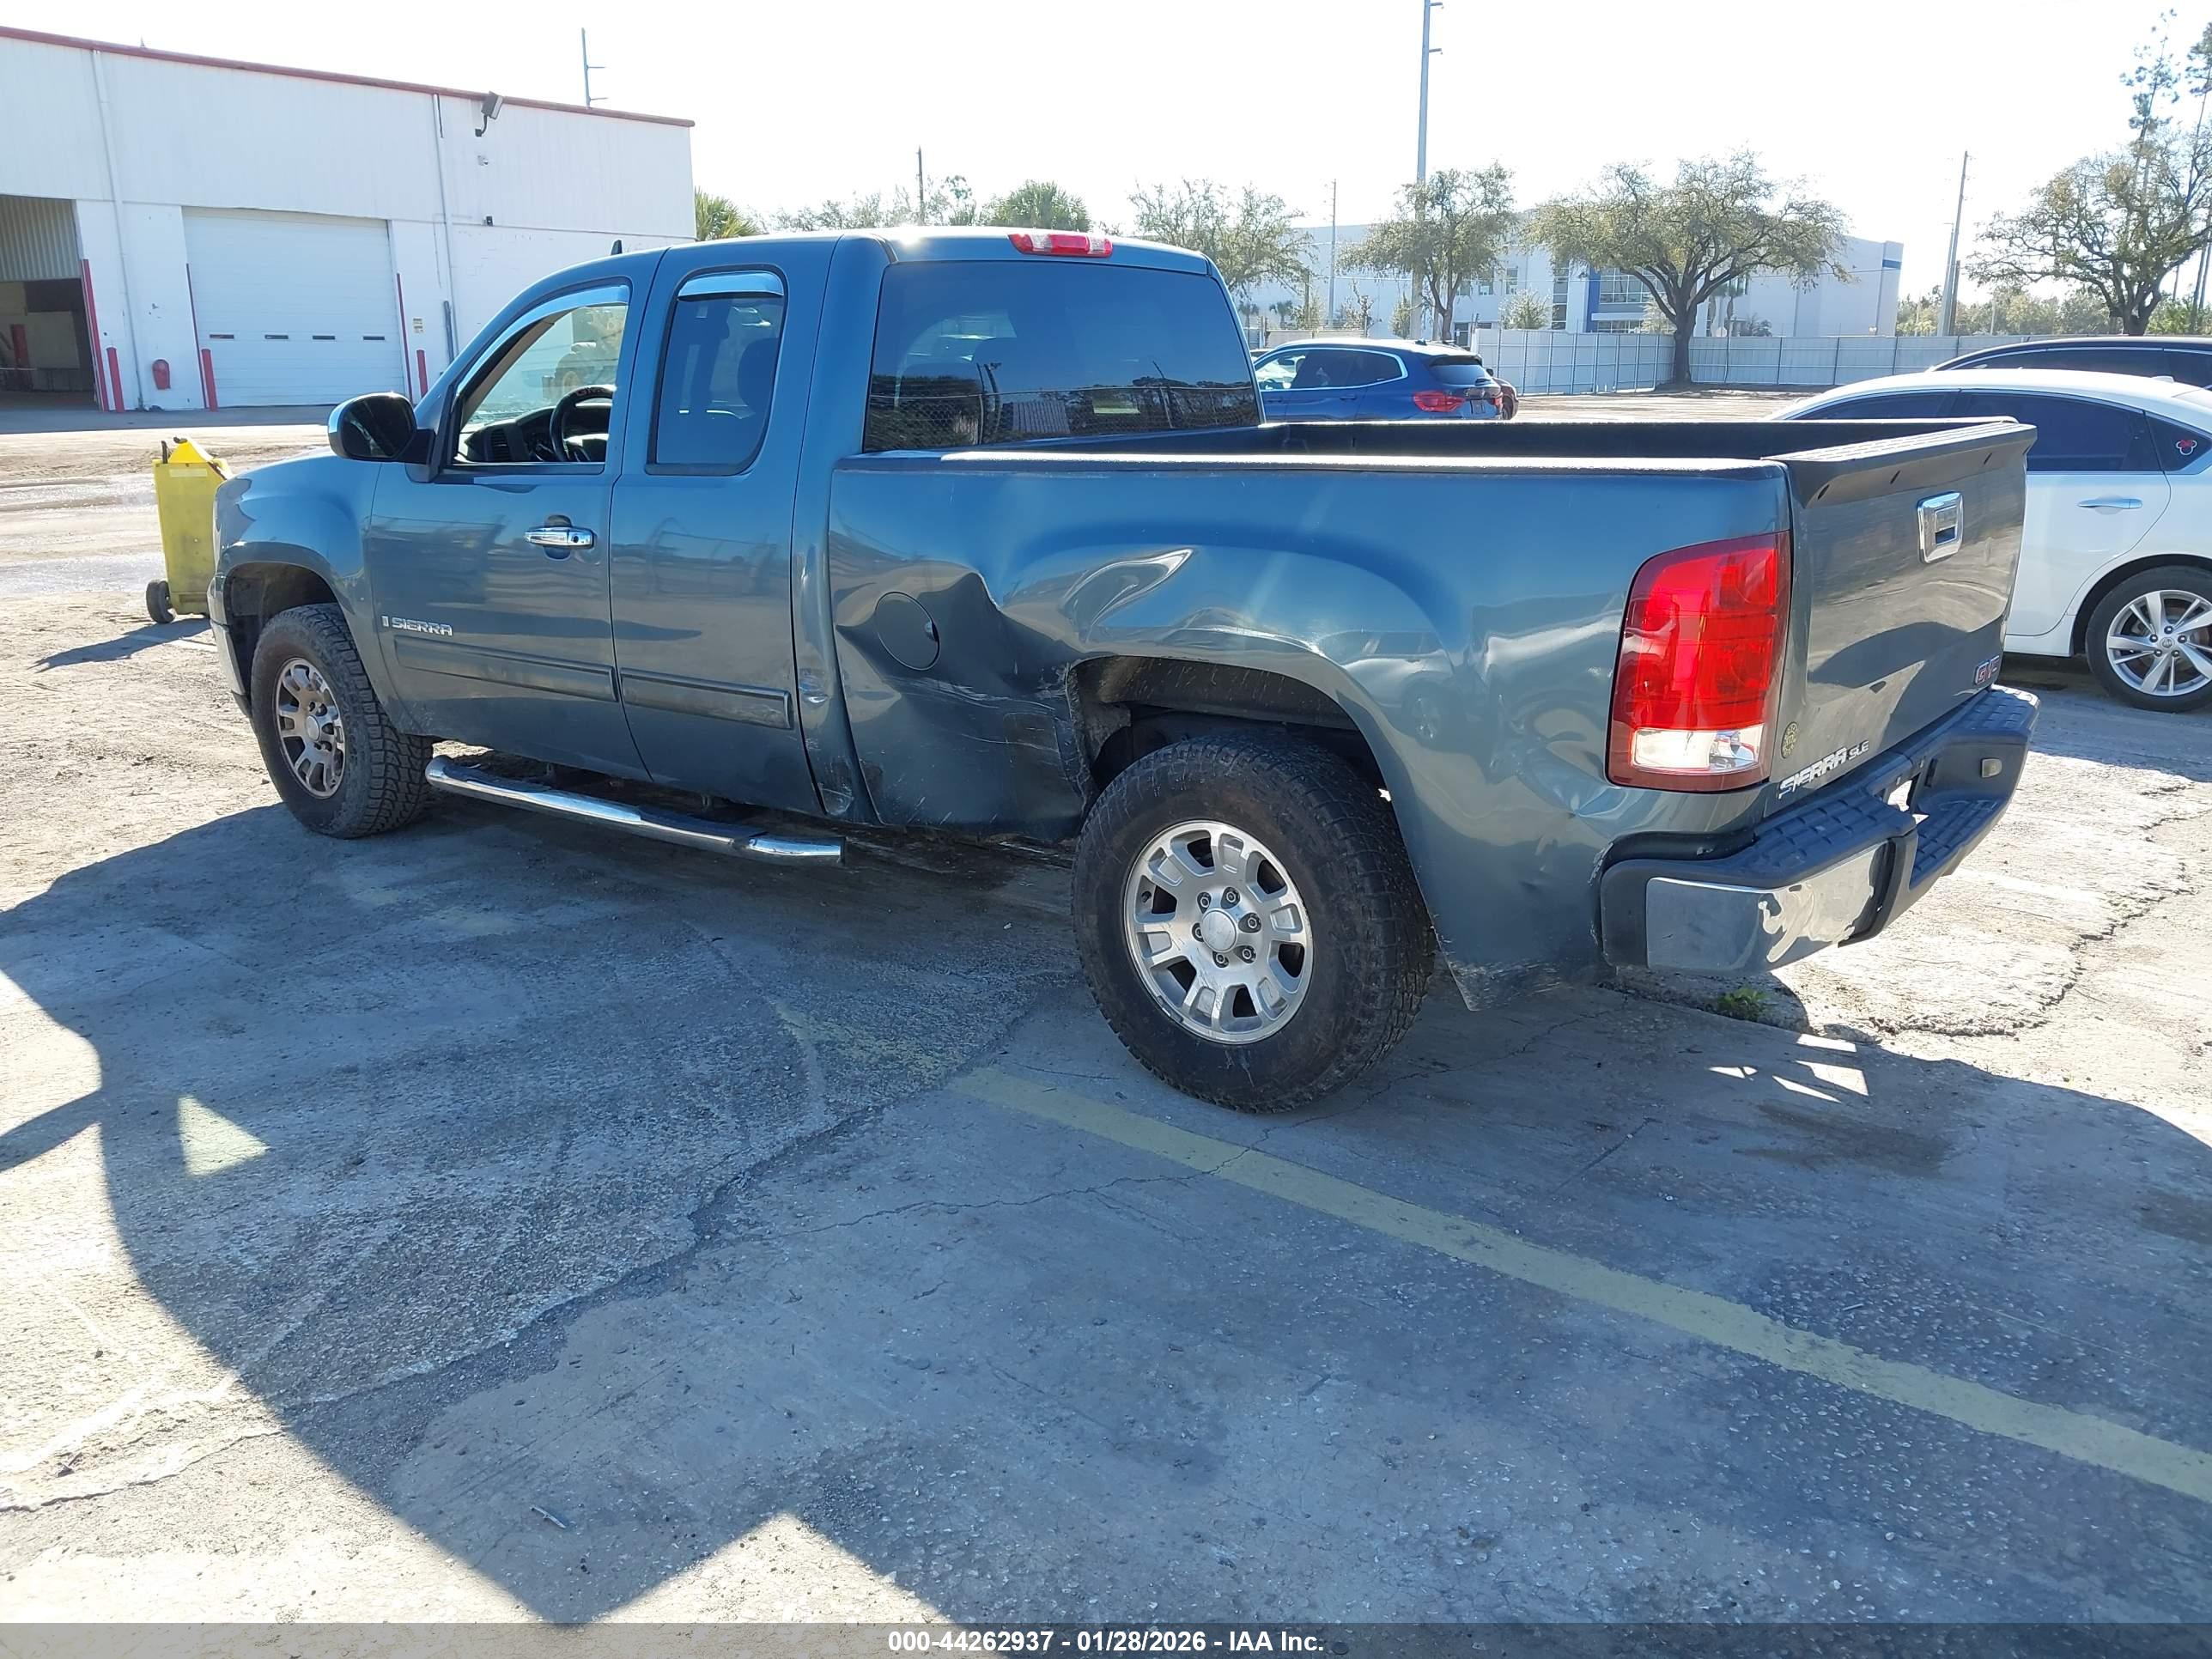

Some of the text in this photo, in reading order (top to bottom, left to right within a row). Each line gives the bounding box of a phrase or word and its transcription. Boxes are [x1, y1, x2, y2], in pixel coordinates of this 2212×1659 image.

[392, 617, 453, 636] SIERRA
[1778, 740, 1869, 799] SIERRA SLE
